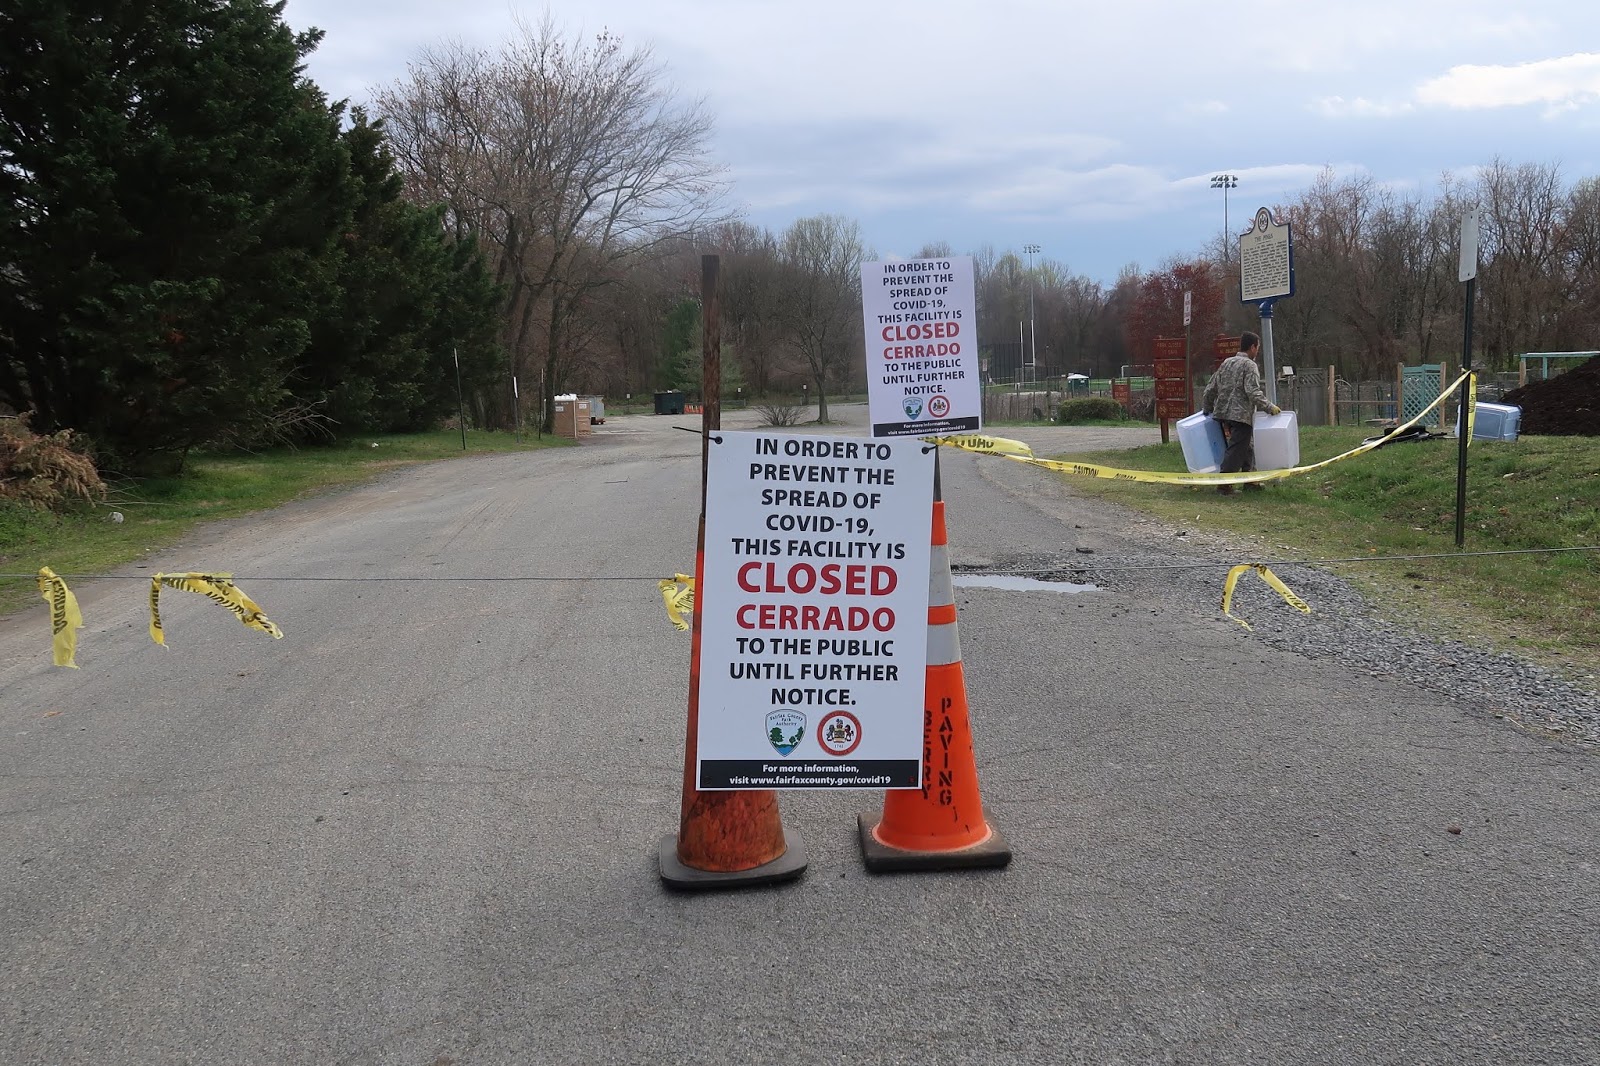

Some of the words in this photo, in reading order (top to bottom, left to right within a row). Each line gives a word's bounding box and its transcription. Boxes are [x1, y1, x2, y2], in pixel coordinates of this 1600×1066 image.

[885, 265, 895, 273] IN
[899, 263, 934, 272] ORDER
[936, 262, 950, 270] TO
[883, 275, 930, 286] PREVENT
[934, 274, 953, 282] THE
[890, 288, 931, 298] SPREAD
[935, 286, 947, 295] OF
[894, 300, 945, 310] COVID-19,
[878, 314, 902, 323] THIS
[905, 311, 949, 322] FACILITY
[953, 310, 962, 318] IS
[882, 322, 959, 341] CLOSED
[884, 343, 960, 359] CERRADO
[885, 364, 898, 372] TO
[901, 362, 921, 370] THE
[924, 359, 961, 369] PUBLIC
[883, 375, 914, 384] UNTIL
[918, 371, 964, 382] FURTHER
[905, 385, 945, 395] NOTICE.
[756, 438, 777, 455] IN
[784, 440, 858, 458] ORDER
[864, 444, 891, 460] TO
[750, 464, 849, 483] PREVENT
[854, 468, 894, 485] THE
[762, 489, 847, 508] SPREAD
[853, 493, 880, 509] OF
[766, 514, 874, 536] COVID-19,
[732, 538, 781, 555] THIS
[788, 540, 881, 558] FACILITY
[888, 544, 904, 559] IS
[738, 562, 897, 596] CLOSED
[737, 604, 895, 632] CERRADO
[736, 638, 764, 654] TO
[770, 638, 811, 654] THE
[818, 640, 893, 656] PUBLIC
[730, 663, 794, 679] UNTIL
[801, 664, 898, 680] FURTHER
[772, 689, 856, 705] NOTICE.
[939, 698, 953, 806] PAVING
[804, 764, 859, 773] information,
[730, 776, 748, 784] visit
[751, 776, 890, 785] www.fairfaxcounty.gov/covid19
